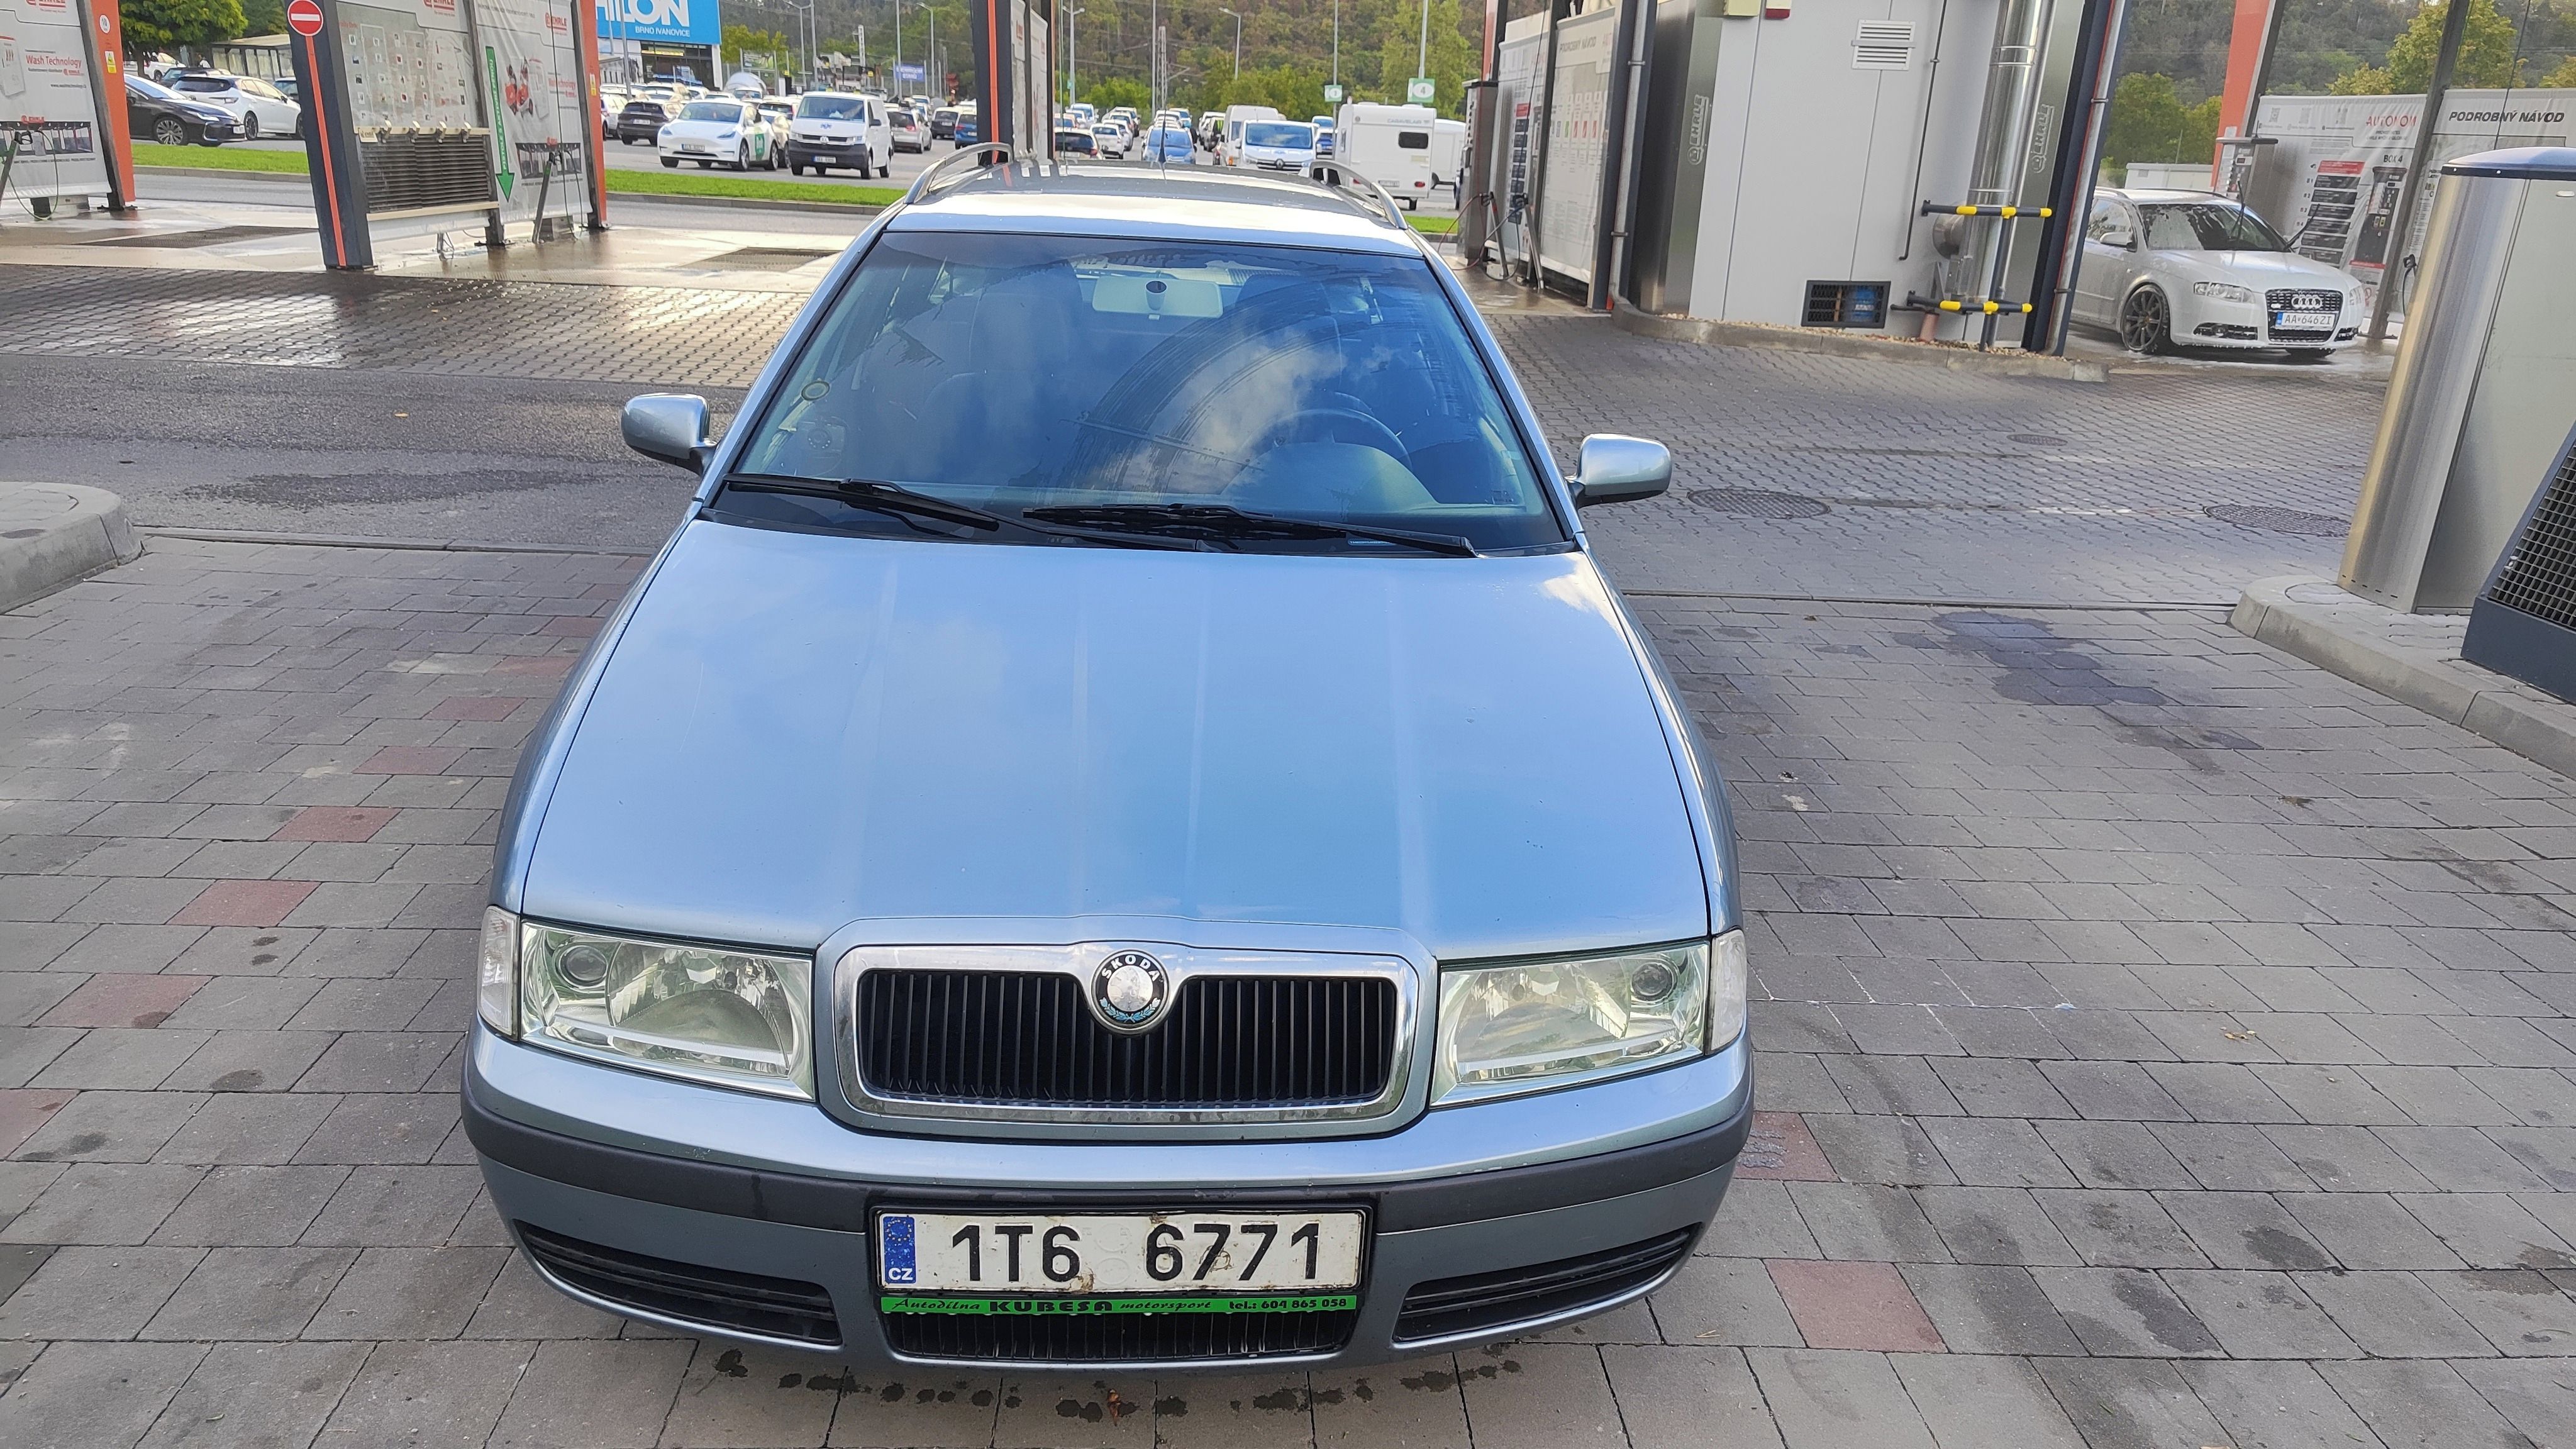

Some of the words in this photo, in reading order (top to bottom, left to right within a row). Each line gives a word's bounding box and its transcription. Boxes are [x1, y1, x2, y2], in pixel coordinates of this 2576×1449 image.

[635, 26, 654, 34] BRNO
[655, 28, 691, 37] IVANOVICE
[26, 55, 44, 65] Wash
[45, 55, 82, 68] Technology
[1419, 86, 1426, 95] 4
[2449, 110, 2518, 122] PODROBNÝ
[2518, 110, 2565, 123] NÁVOD
[952, 1224, 1081, 1282] 1T6
[1145, 1223, 1319, 1281] 6771
[888, 1267, 913, 1281] CZ
[989, 1301, 1113, 1313] KUBESA
[1119, 1301, 1211, 1311] motorsport
[1229, 1301, 1257, 1310] tel.:
[1261, 1300, 1287, 1309] 604
[1292, 1299, 1317, 1309] 865
[1321, 1298, 1347, 1308] 058
